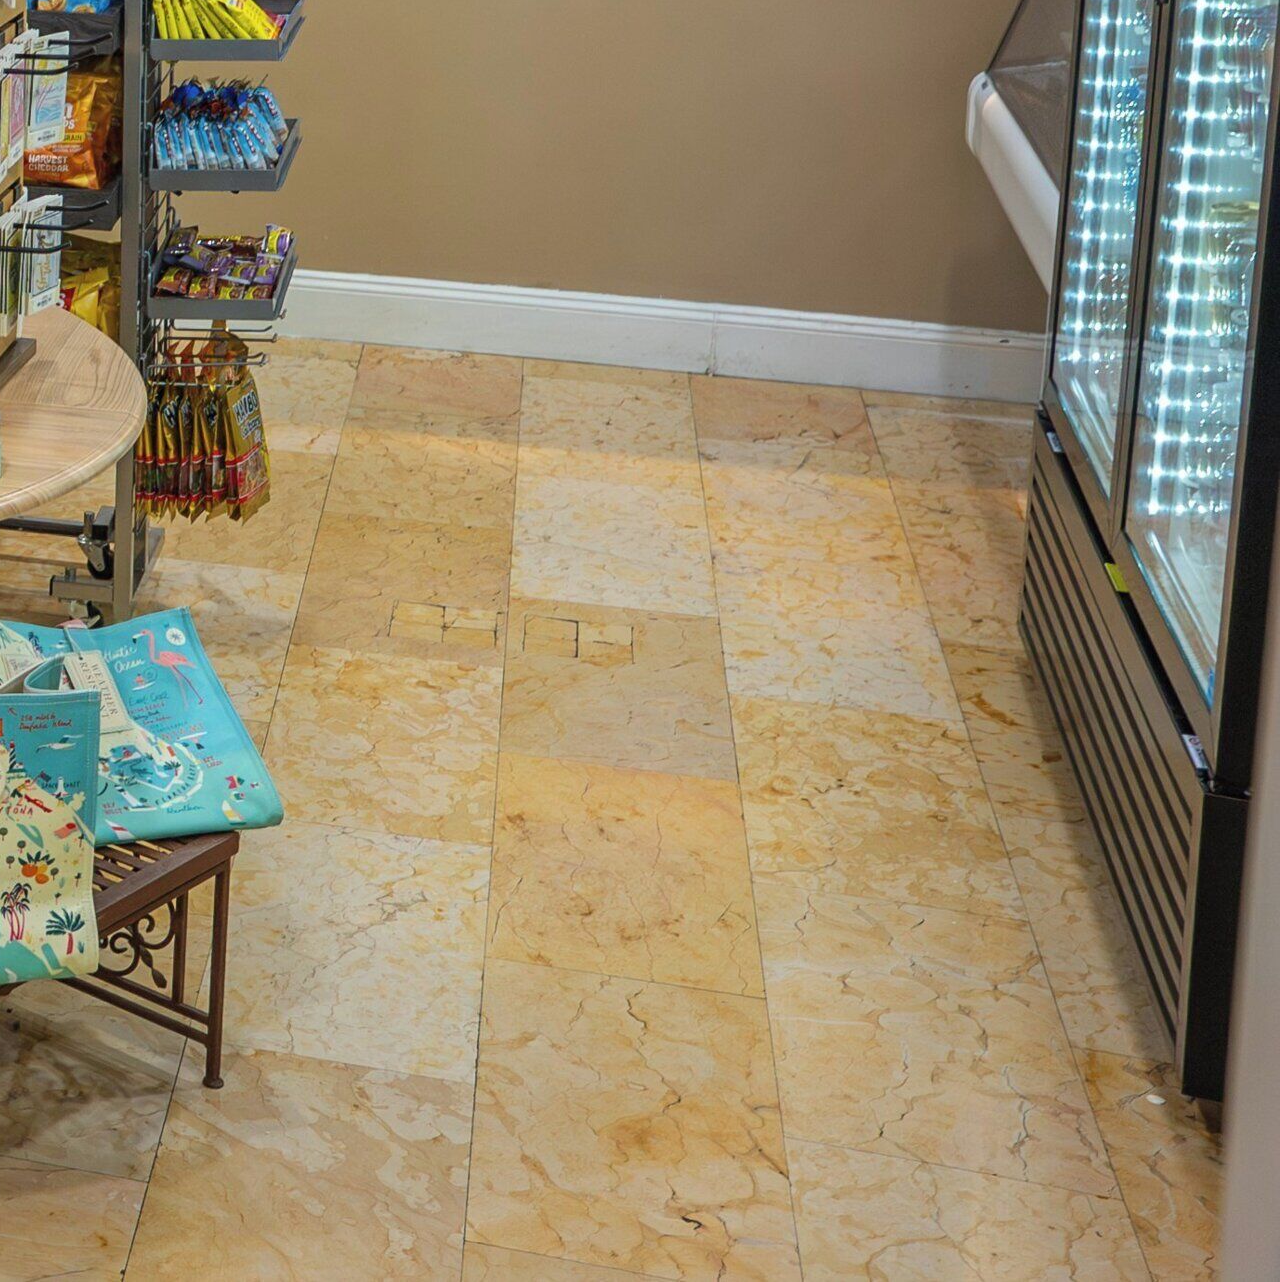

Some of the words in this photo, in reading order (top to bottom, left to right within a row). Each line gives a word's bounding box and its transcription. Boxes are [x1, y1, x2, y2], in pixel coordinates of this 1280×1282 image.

[28, 154, 68, 165] HARVEST
[28, 164, 70, 174] CHEDDAR
[90, 662, 119, 716] WEATHER
